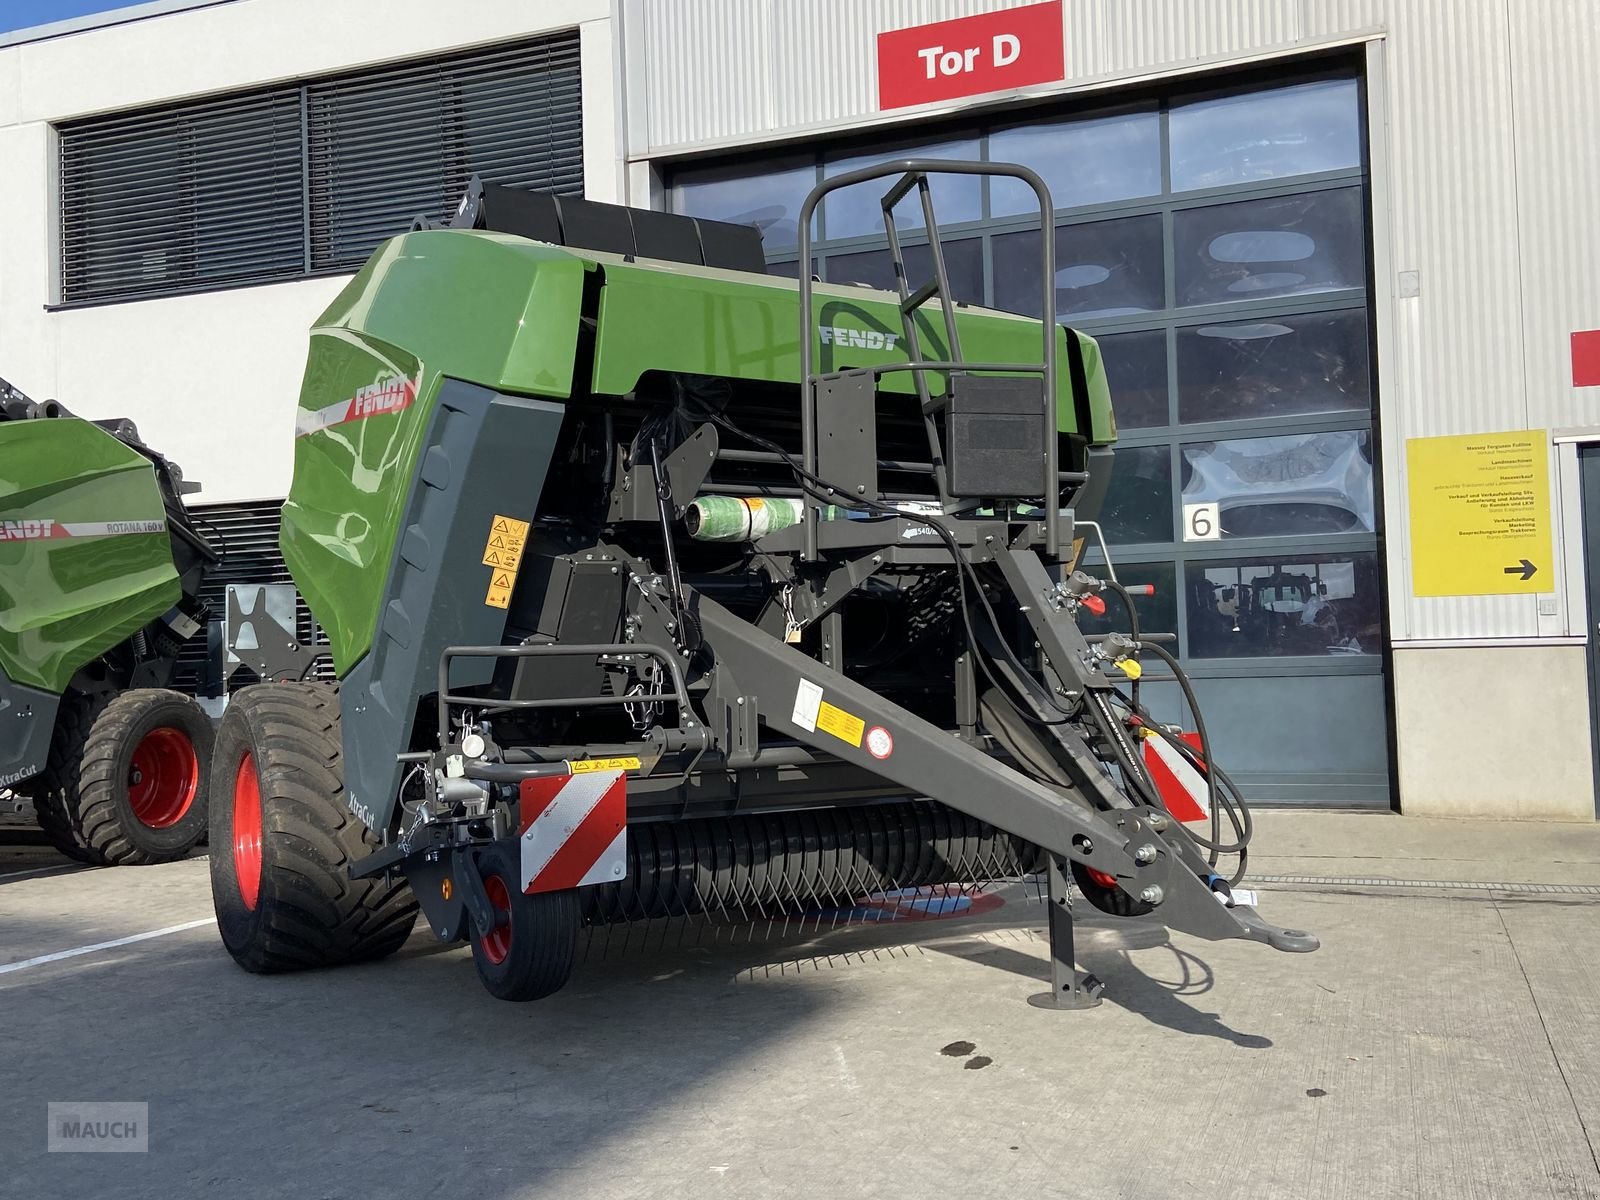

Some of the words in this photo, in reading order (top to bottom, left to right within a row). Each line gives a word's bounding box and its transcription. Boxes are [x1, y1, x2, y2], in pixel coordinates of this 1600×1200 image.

[918, 45, 980, 79] Tor
[993, 33, 1021, 68] D
[818, 325, 900, 351] FENDT
[354, 374, 409, 416] FENDT
[106, 522, 141, 534] ROTANA
[1191, 507, 1211, 537] 6
[0, 764, 37, 787] XtraCut
[348, 790, 375, 831] XtraCut
